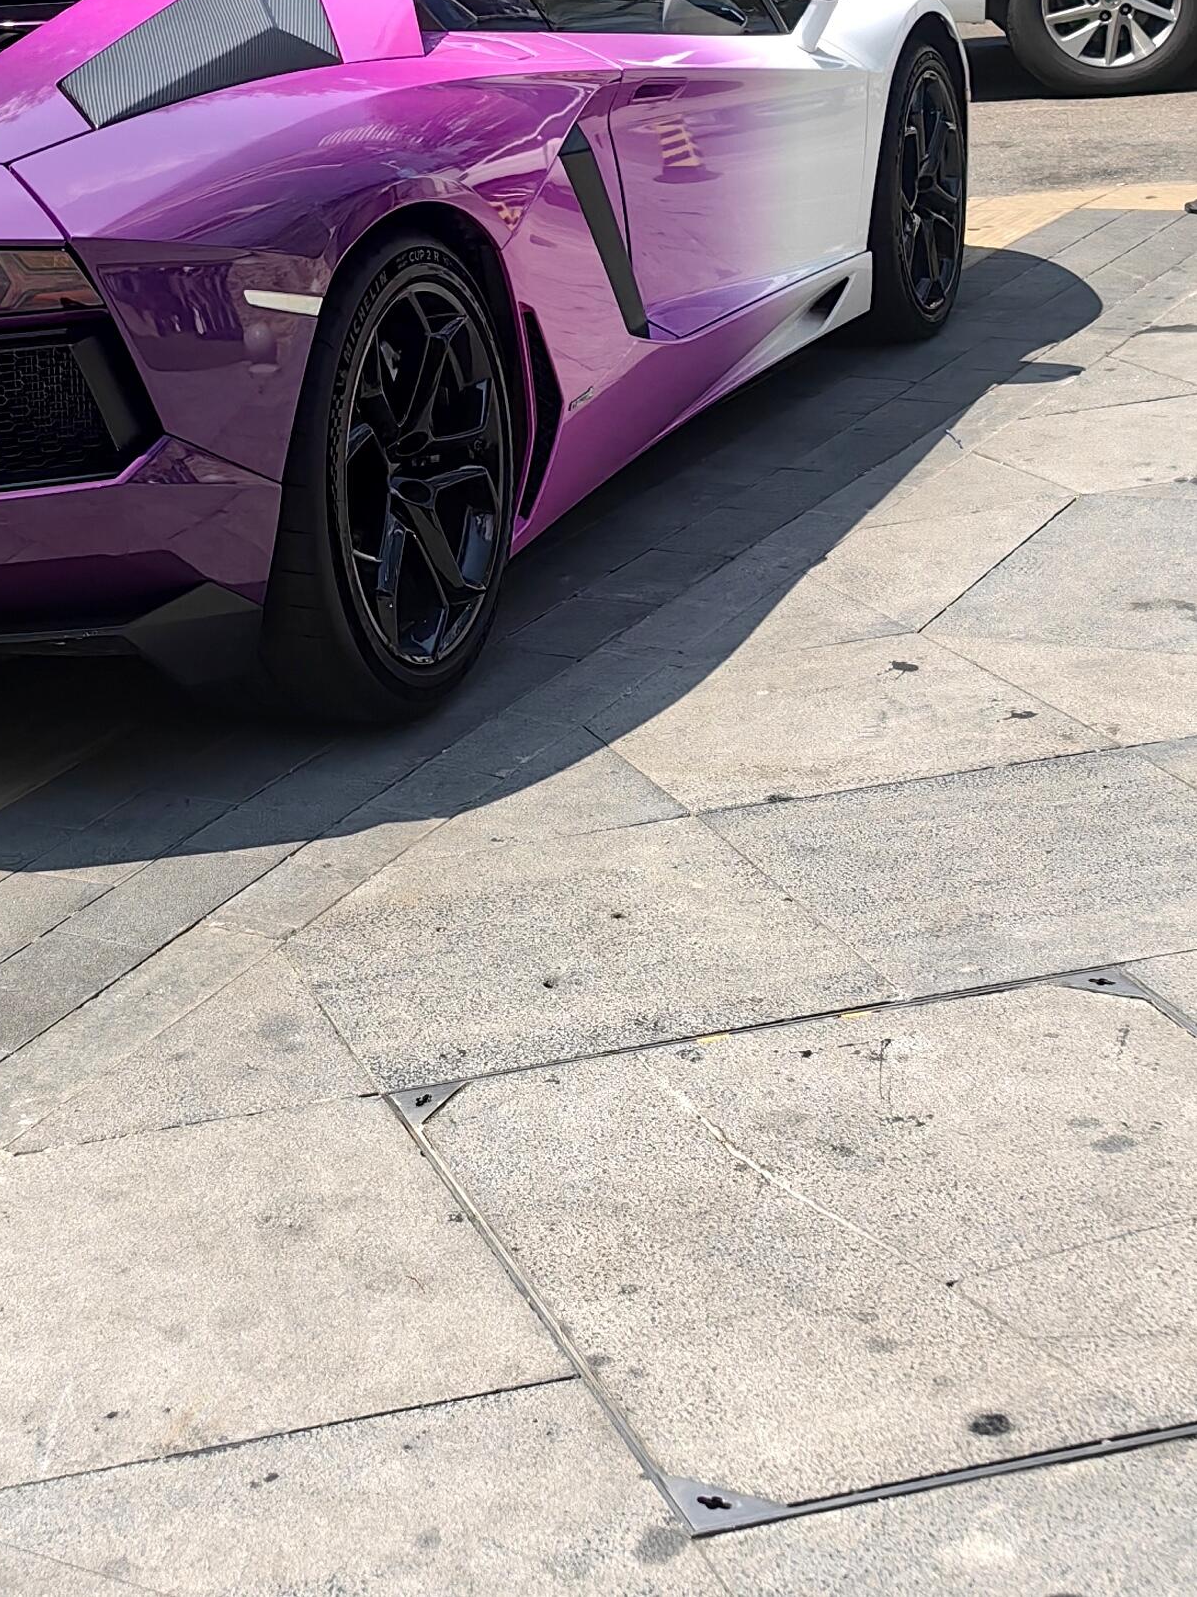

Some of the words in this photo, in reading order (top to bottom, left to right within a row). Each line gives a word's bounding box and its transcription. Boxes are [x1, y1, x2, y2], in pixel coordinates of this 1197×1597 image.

[408, 249, 425, 262] CUP
[426, 250, 431, 260] 2
[433, 251, 440, 262] R
[343, 270, 388, 364] MICHELIN
